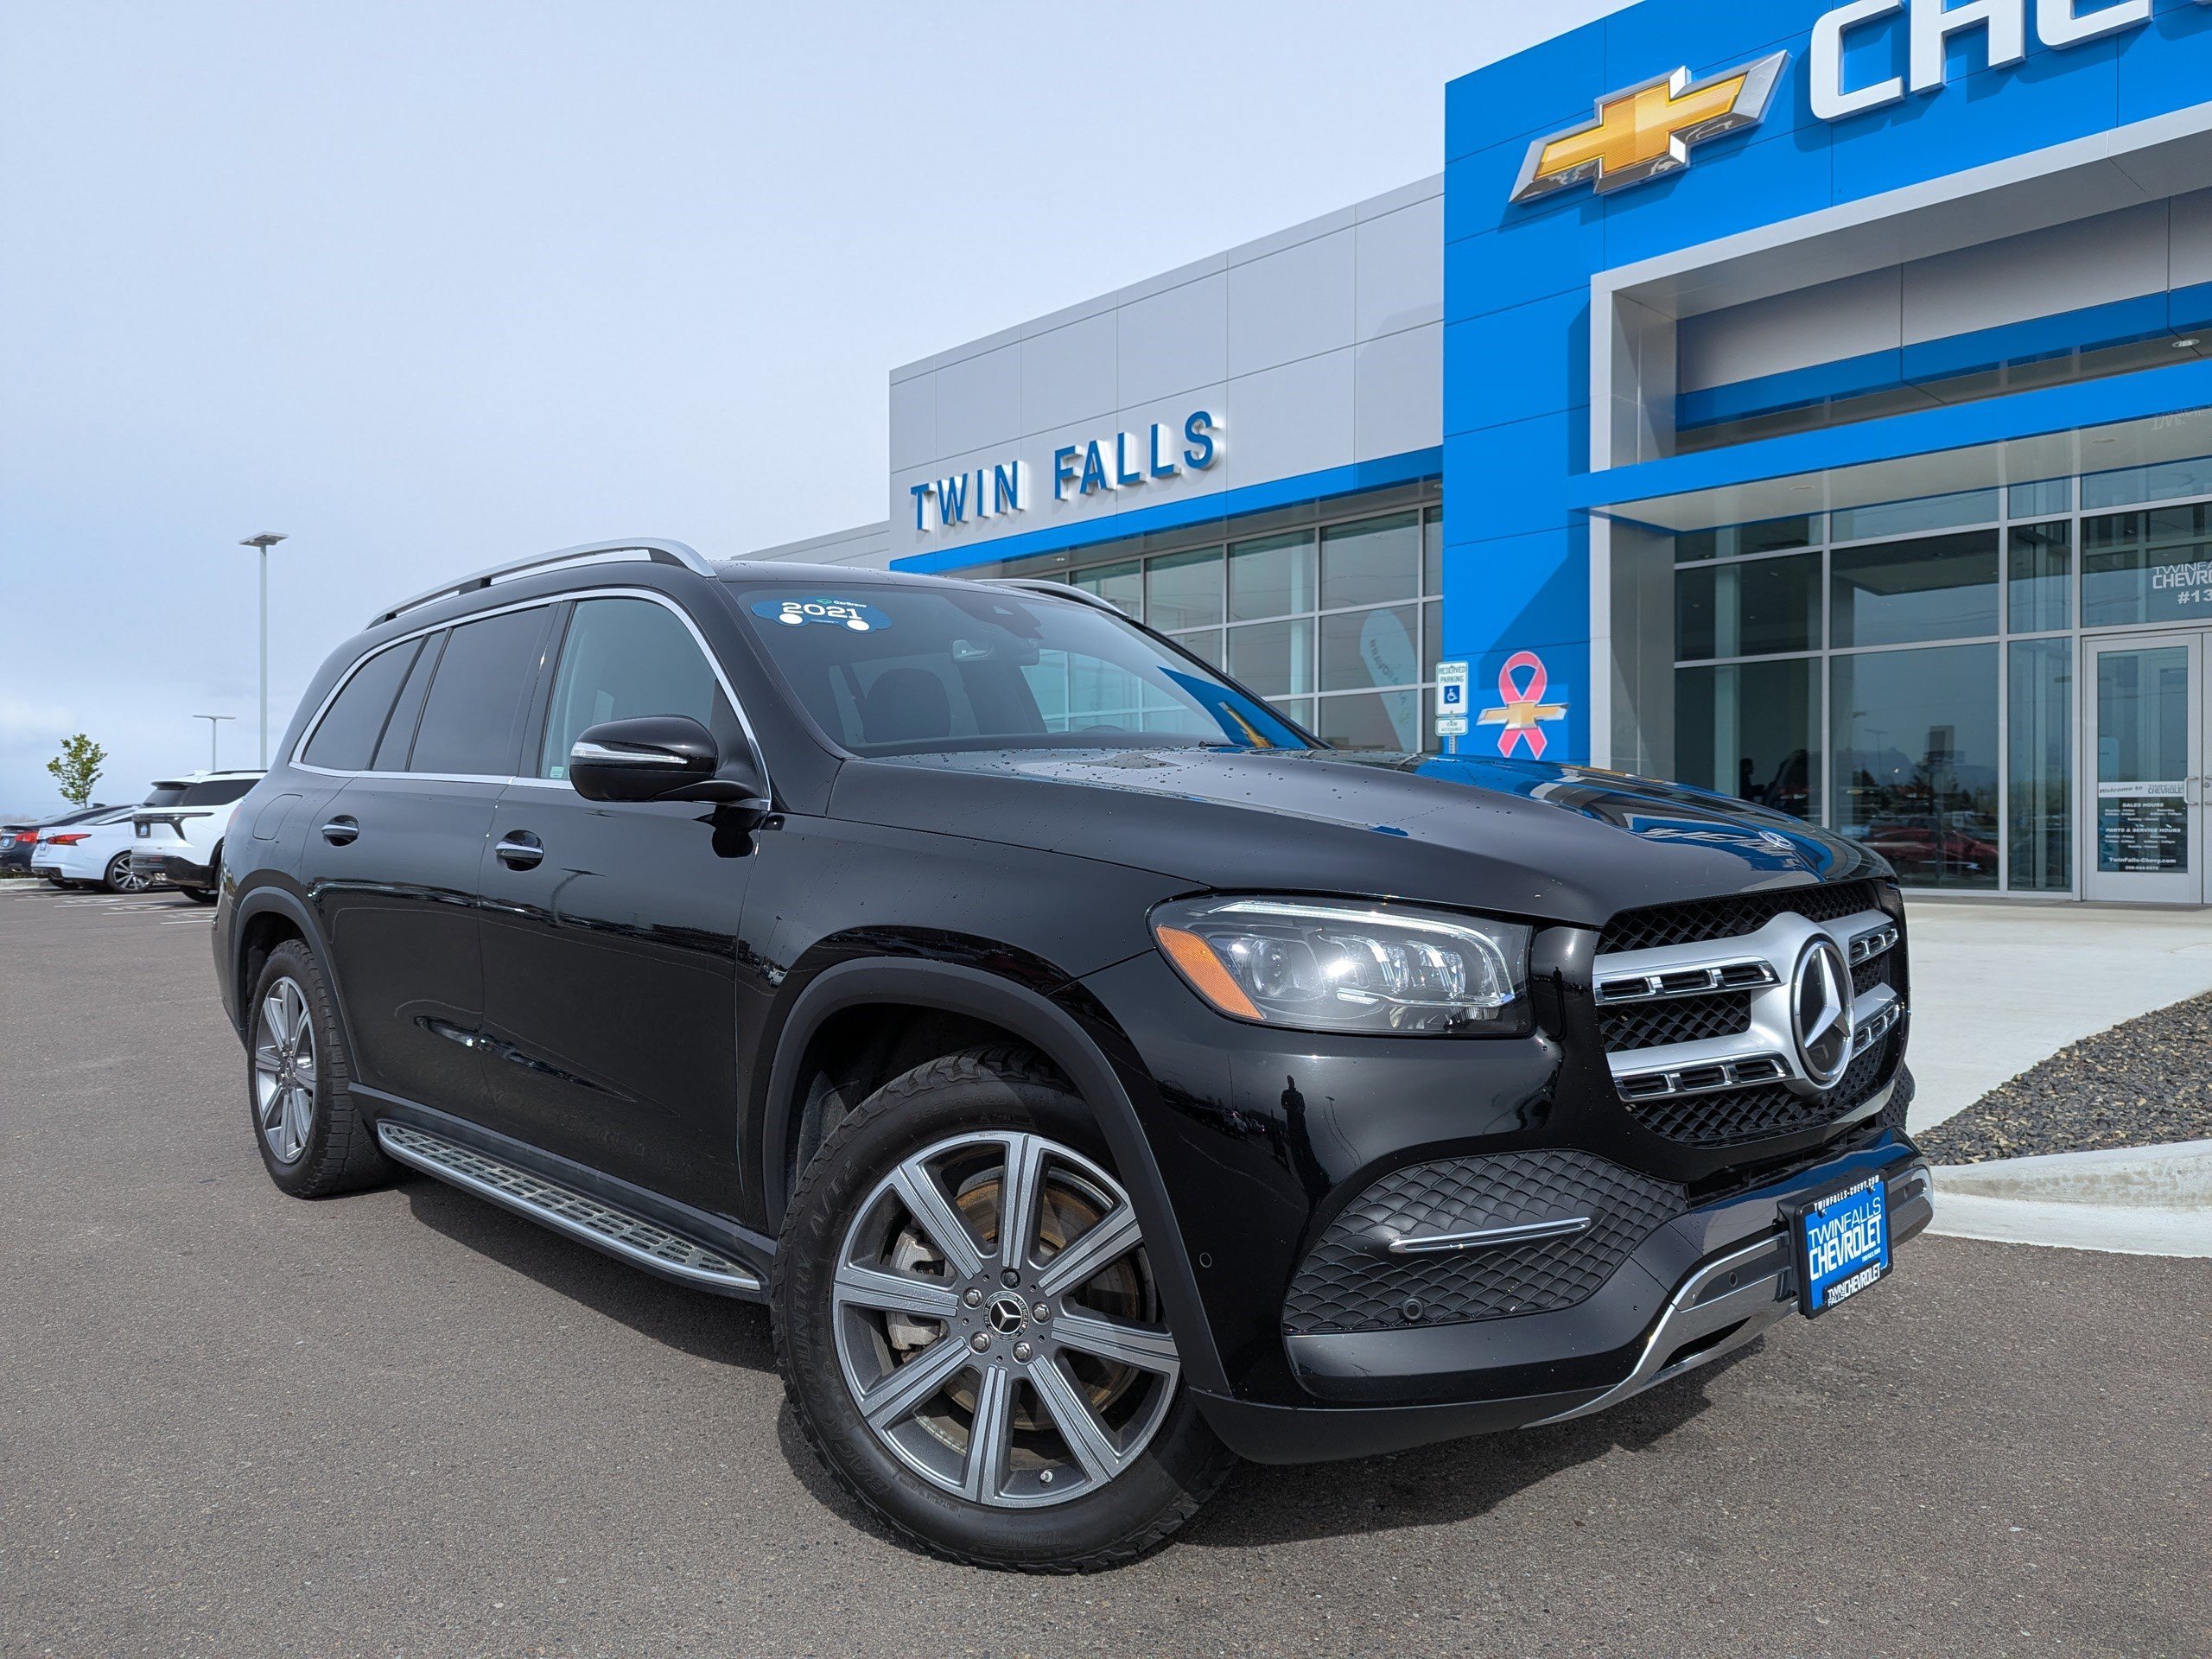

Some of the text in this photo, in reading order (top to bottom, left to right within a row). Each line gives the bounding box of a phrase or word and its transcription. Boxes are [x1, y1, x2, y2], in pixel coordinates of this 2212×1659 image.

[911, 410, 1217, 531] TWIN FALLS
[782, 601, 862, 620] 2021
[1438, 665, 1465, 675] RESERVED
[1814, 1175, 1879, 1211] TWINFALLS-CHEVY.COM
[1808, 1197, 1881, 1249] TWINFALLS
[1809, 1214, 1881, 1281] CHEVROLET
[1827, 1282, 1845, 1300] TWIN
[1844, 1262, 1881, 1297] CHEVROLET
